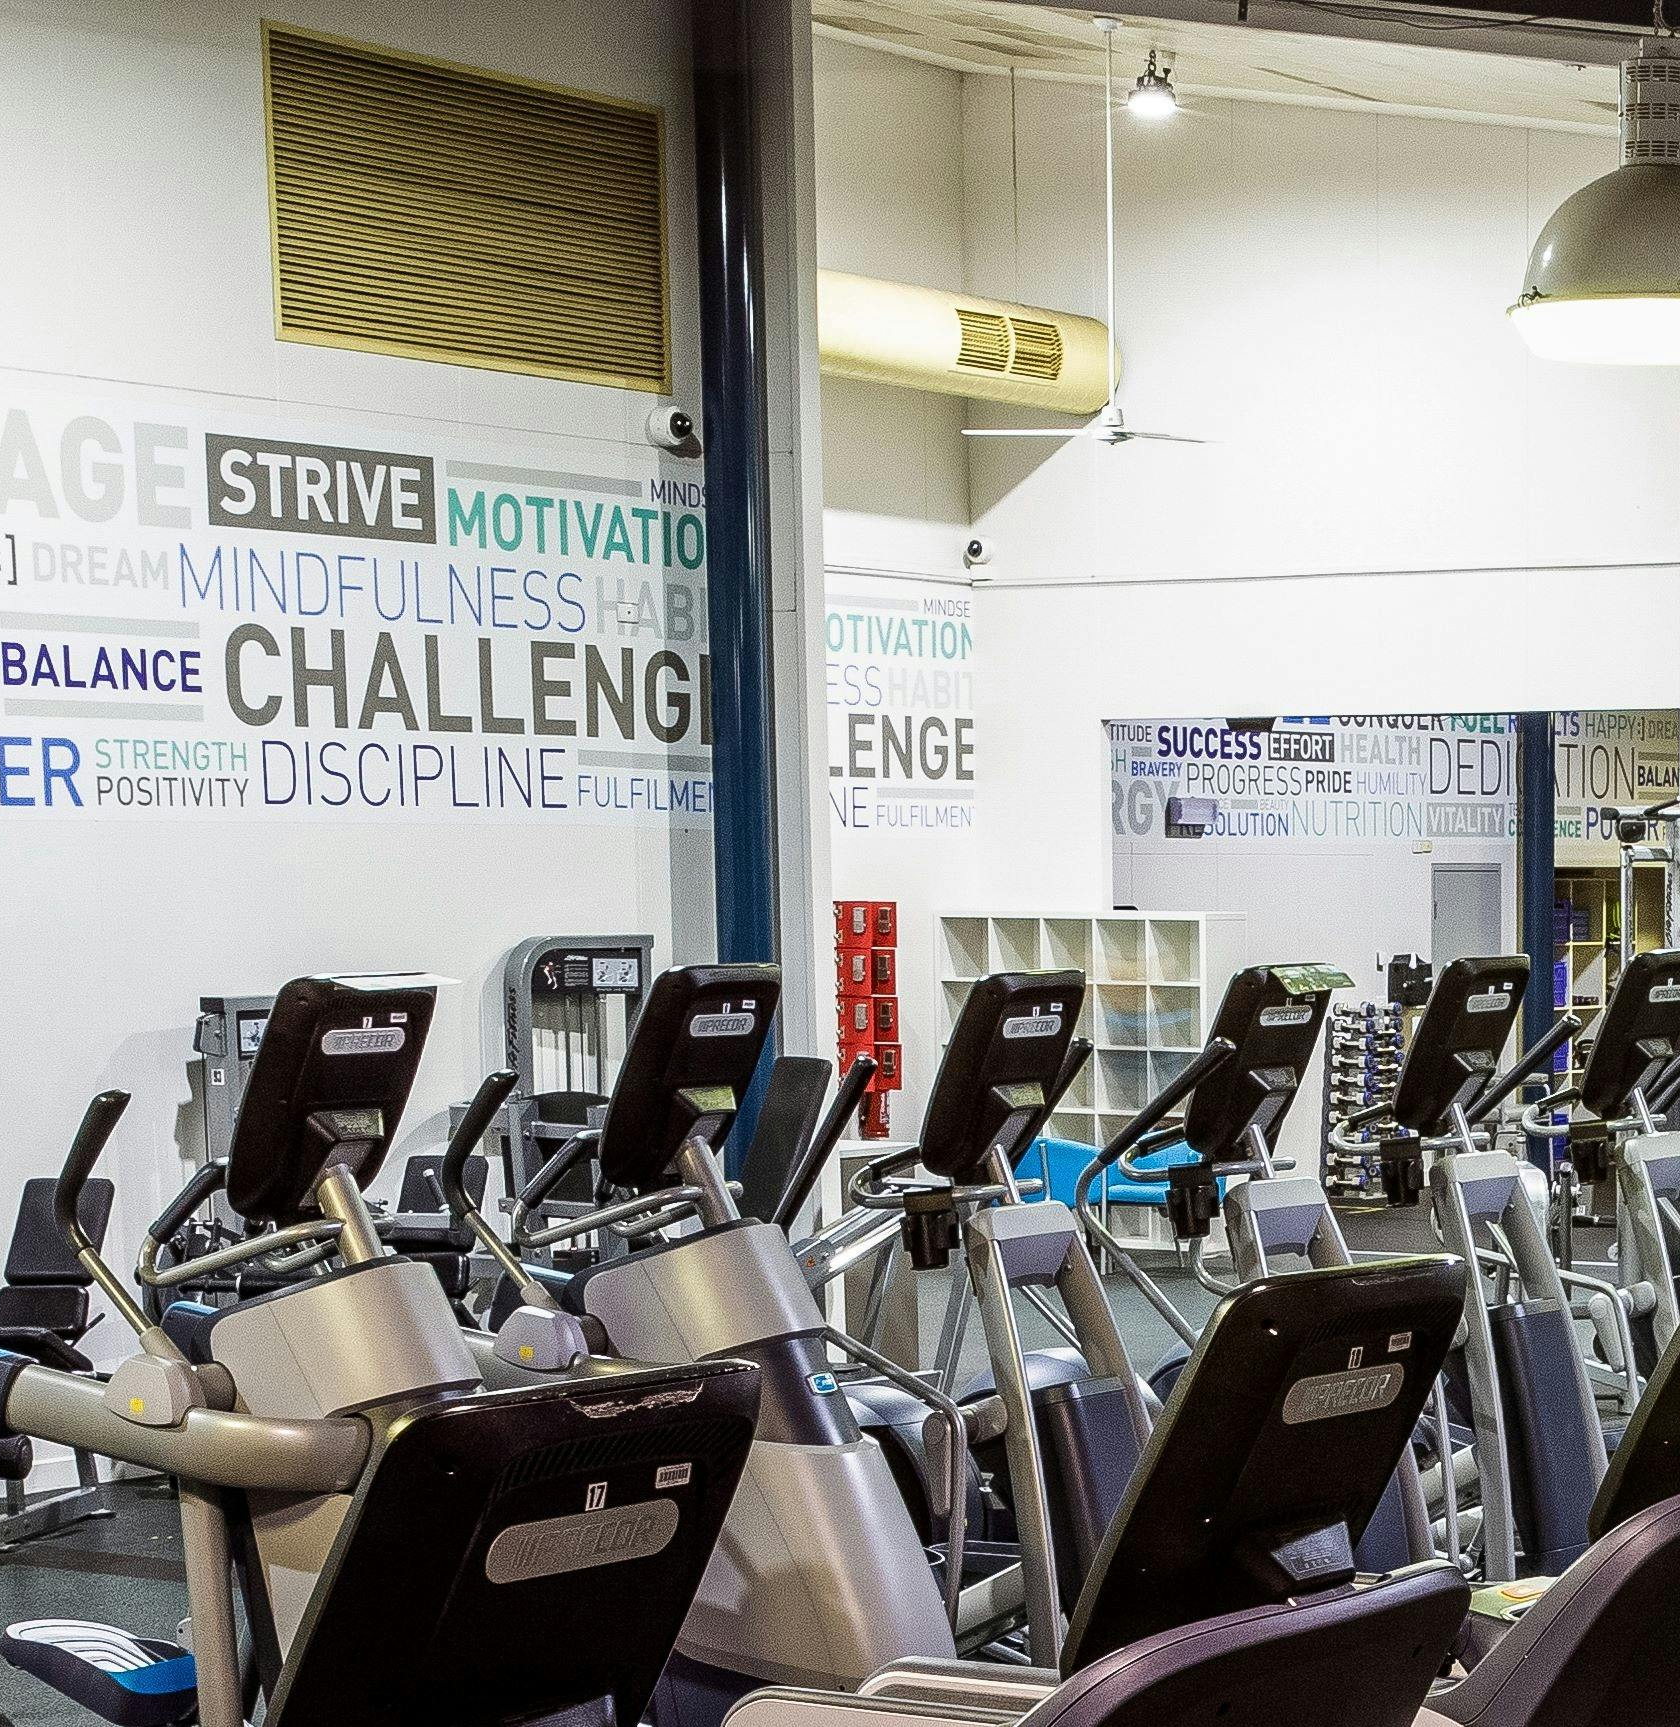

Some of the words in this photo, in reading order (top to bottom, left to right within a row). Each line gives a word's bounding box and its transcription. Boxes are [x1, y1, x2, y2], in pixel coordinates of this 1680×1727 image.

[219, 447, 423, 533] STRIVE
[31, 542, 170, 591] DREAM
[179, 543, 585, 634] MINDFULNESS
[1, 640, 203, 694] BALANCE
[94, 738, 248, 773] STRENGTH
[1157, 725, 1262, 760] SUCCESS
[1272, 734, 1333, 760] EFFORT
[1340, 733, 1421, 766] HEALTH
[262, 740, 567, 810] DISCIPLINE
[1131, 761, 1183, 779] BRAVERY
[1186, 762, 1303, 797] PROGRESS
[1305, 769, 1352, 795] PRIDE
[1356, 772, 1427, 796] HUMILITY
[1429, 737, 1635, 800] DEDITION
[96, 775, 249, 808] POSITIVITY
[1292, 799, 1422, 837] NUTRITION
[1429, 805, 1504, 835] VITALITY
[589, 1484, 607, 1509] 17
